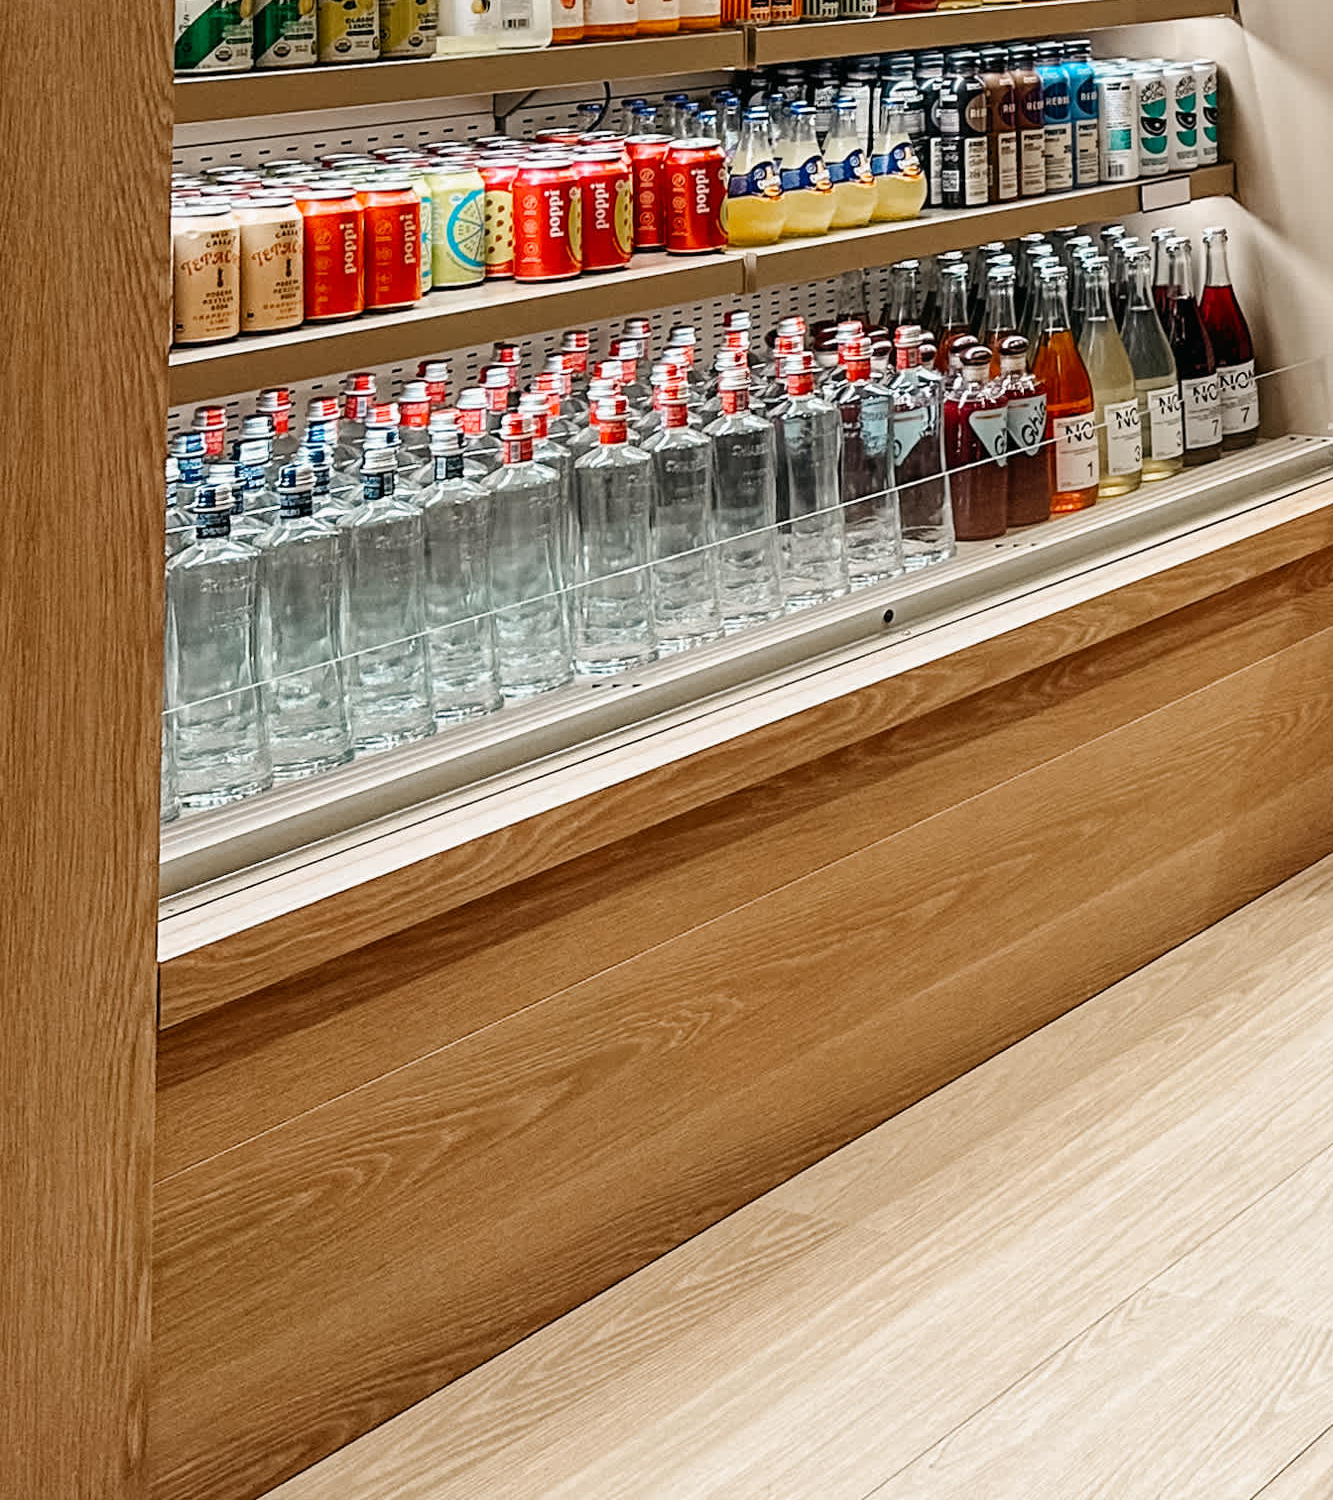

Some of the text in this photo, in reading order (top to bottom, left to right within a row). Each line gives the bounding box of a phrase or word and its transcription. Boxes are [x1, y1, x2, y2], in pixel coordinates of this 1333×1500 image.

[544, 189, 564, 238] poppi
[590, 181, 609, 229] poppi
[691, 168, 710, 214] poppi
[339, 222, 357, 274] poppi
[400, 213, 416, 264] poppi
[1159, 394, 1182, 415] NO
[1193, 382, 1218, 405] NO
[1241, 406, 1250, 424] 7
[1115, 406, 1140, 430] NO
